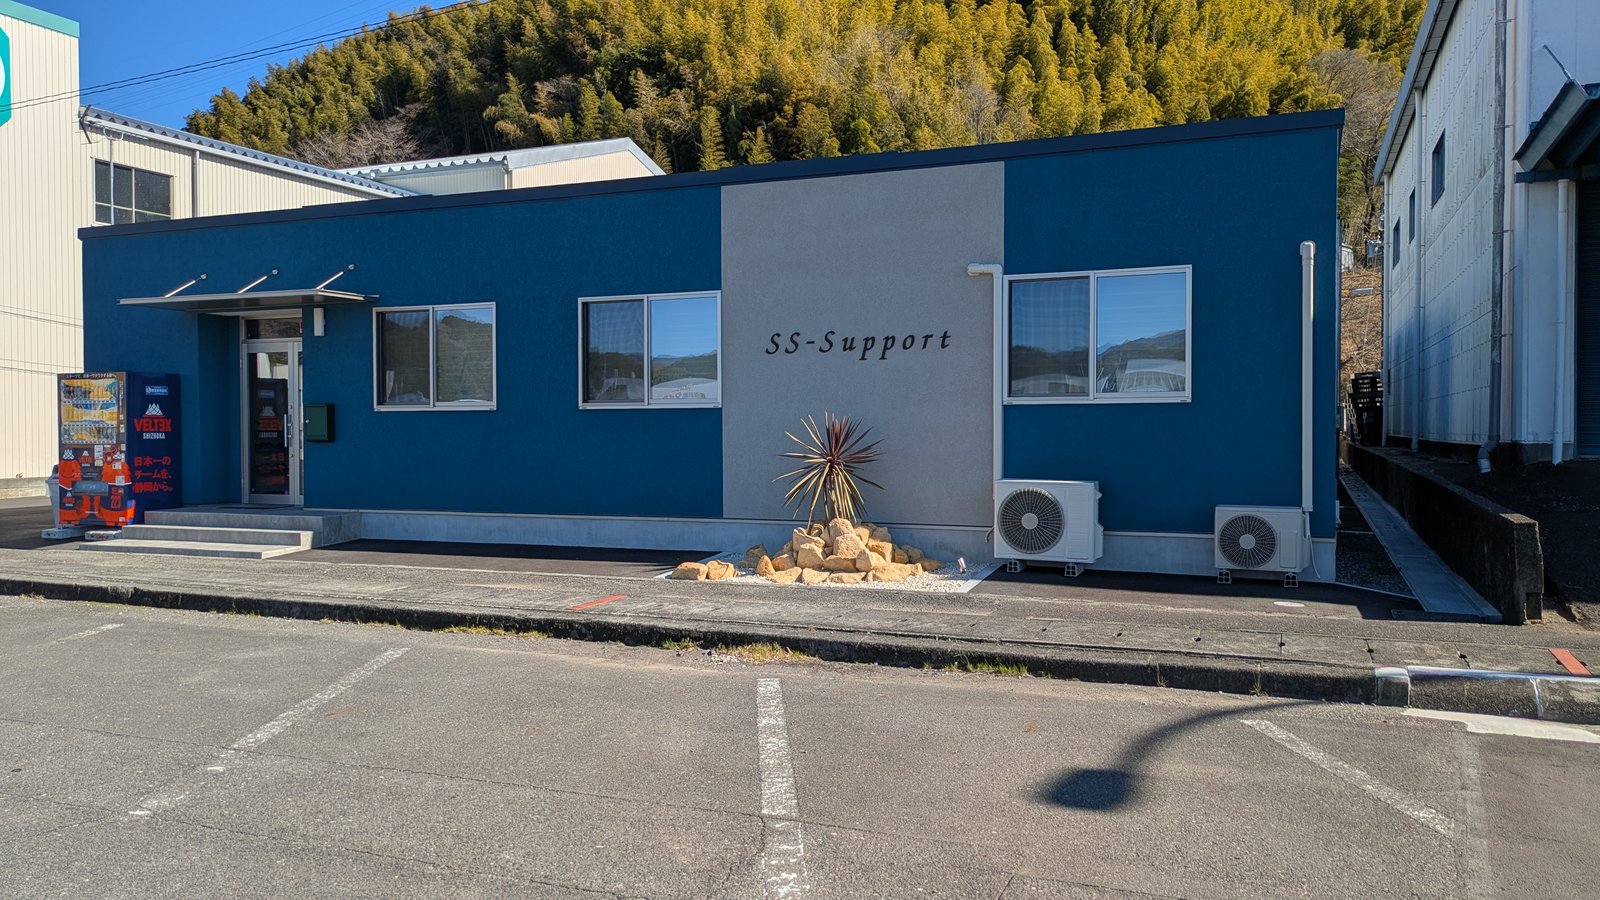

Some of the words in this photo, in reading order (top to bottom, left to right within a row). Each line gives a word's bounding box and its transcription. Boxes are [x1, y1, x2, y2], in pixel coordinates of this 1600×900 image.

[765, 330, 951, 361] SS-Support
[134, 456, 171, 467] 日本一の
